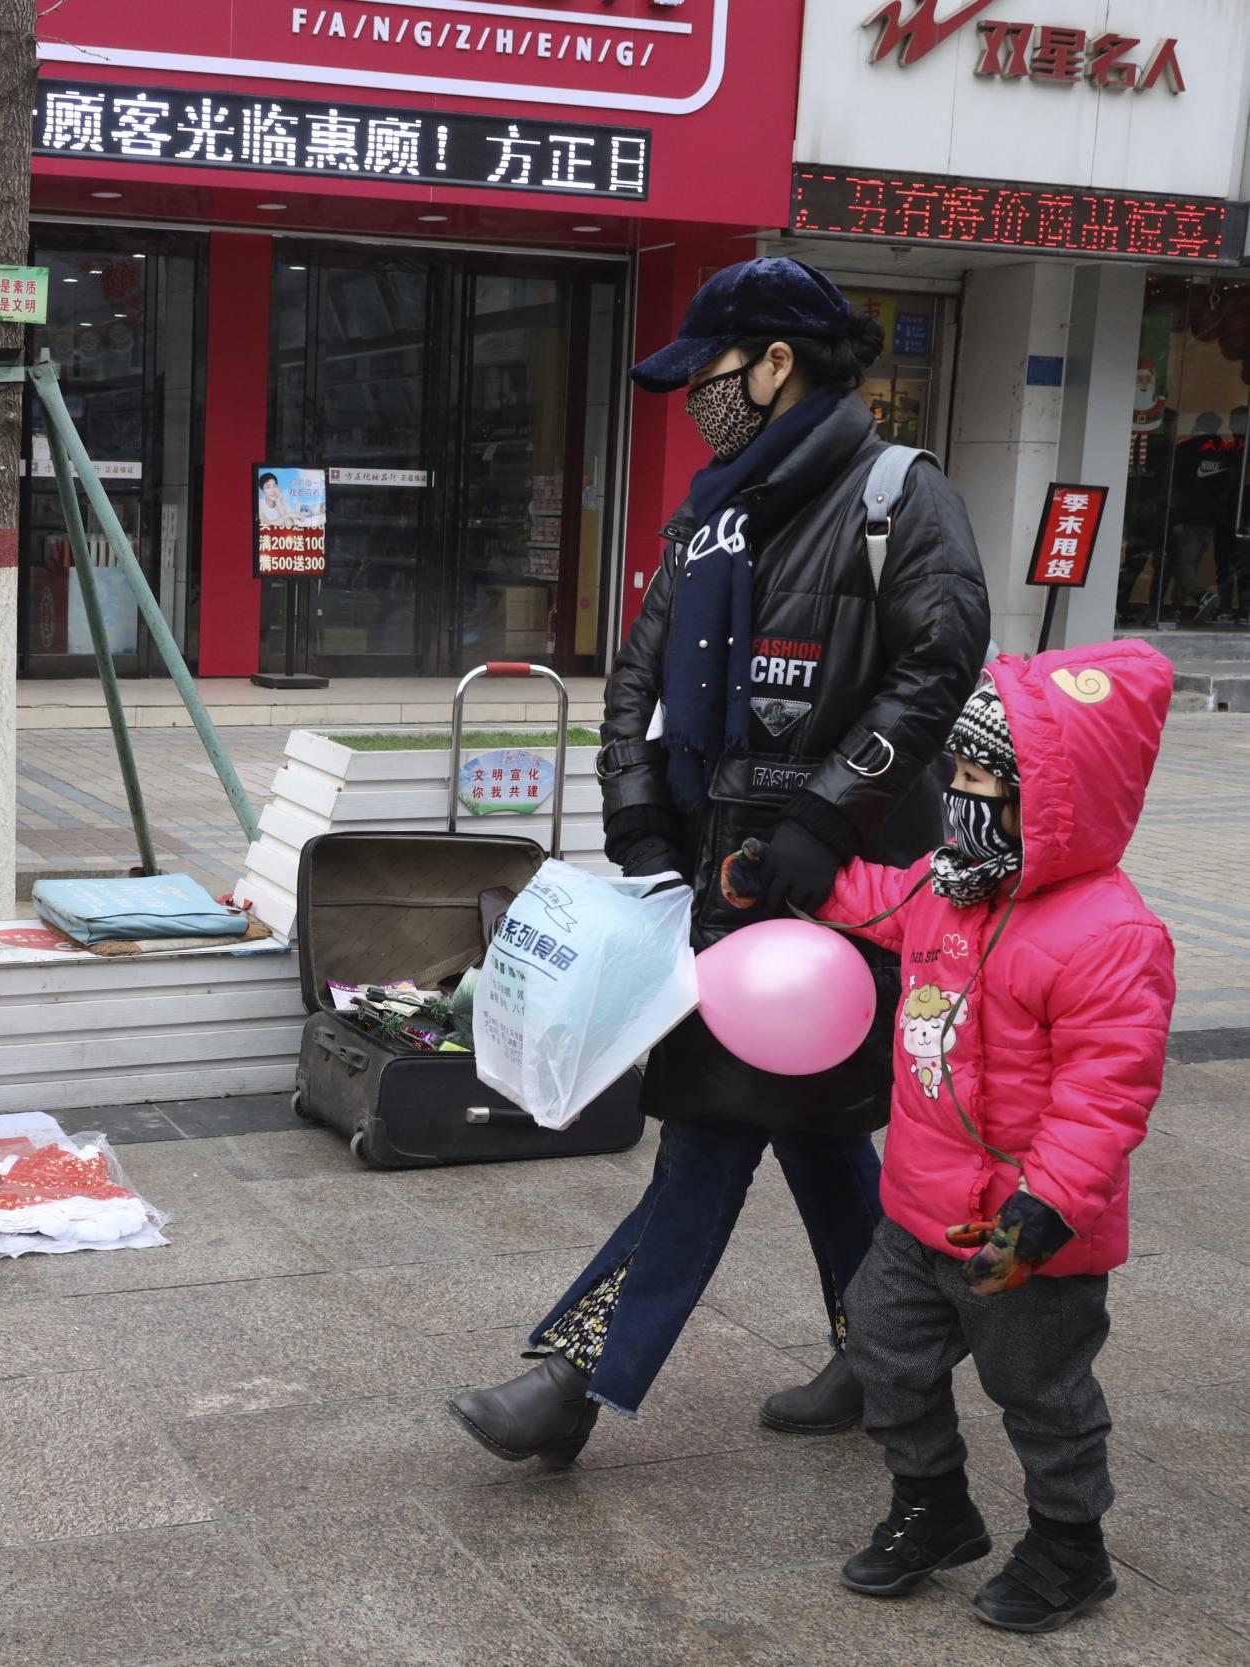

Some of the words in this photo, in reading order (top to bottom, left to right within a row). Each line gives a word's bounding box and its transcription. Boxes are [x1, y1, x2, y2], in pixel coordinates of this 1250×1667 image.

[973, 19, 1186, 94] 双星名人
[485, 125, 646, 193] 方正日
[258, 534, 325, 553] 满200送100
[1044, 493, 1089, 579] 季末甩货
[258, 554, 326, 572] 满500送300
[752, 638, 822, 660] FASHION
[750, 655, 818, 688] CRFT
[473, 767, 540, 782] 文明宣化
[472, 785, 539, 799] 你我共建
